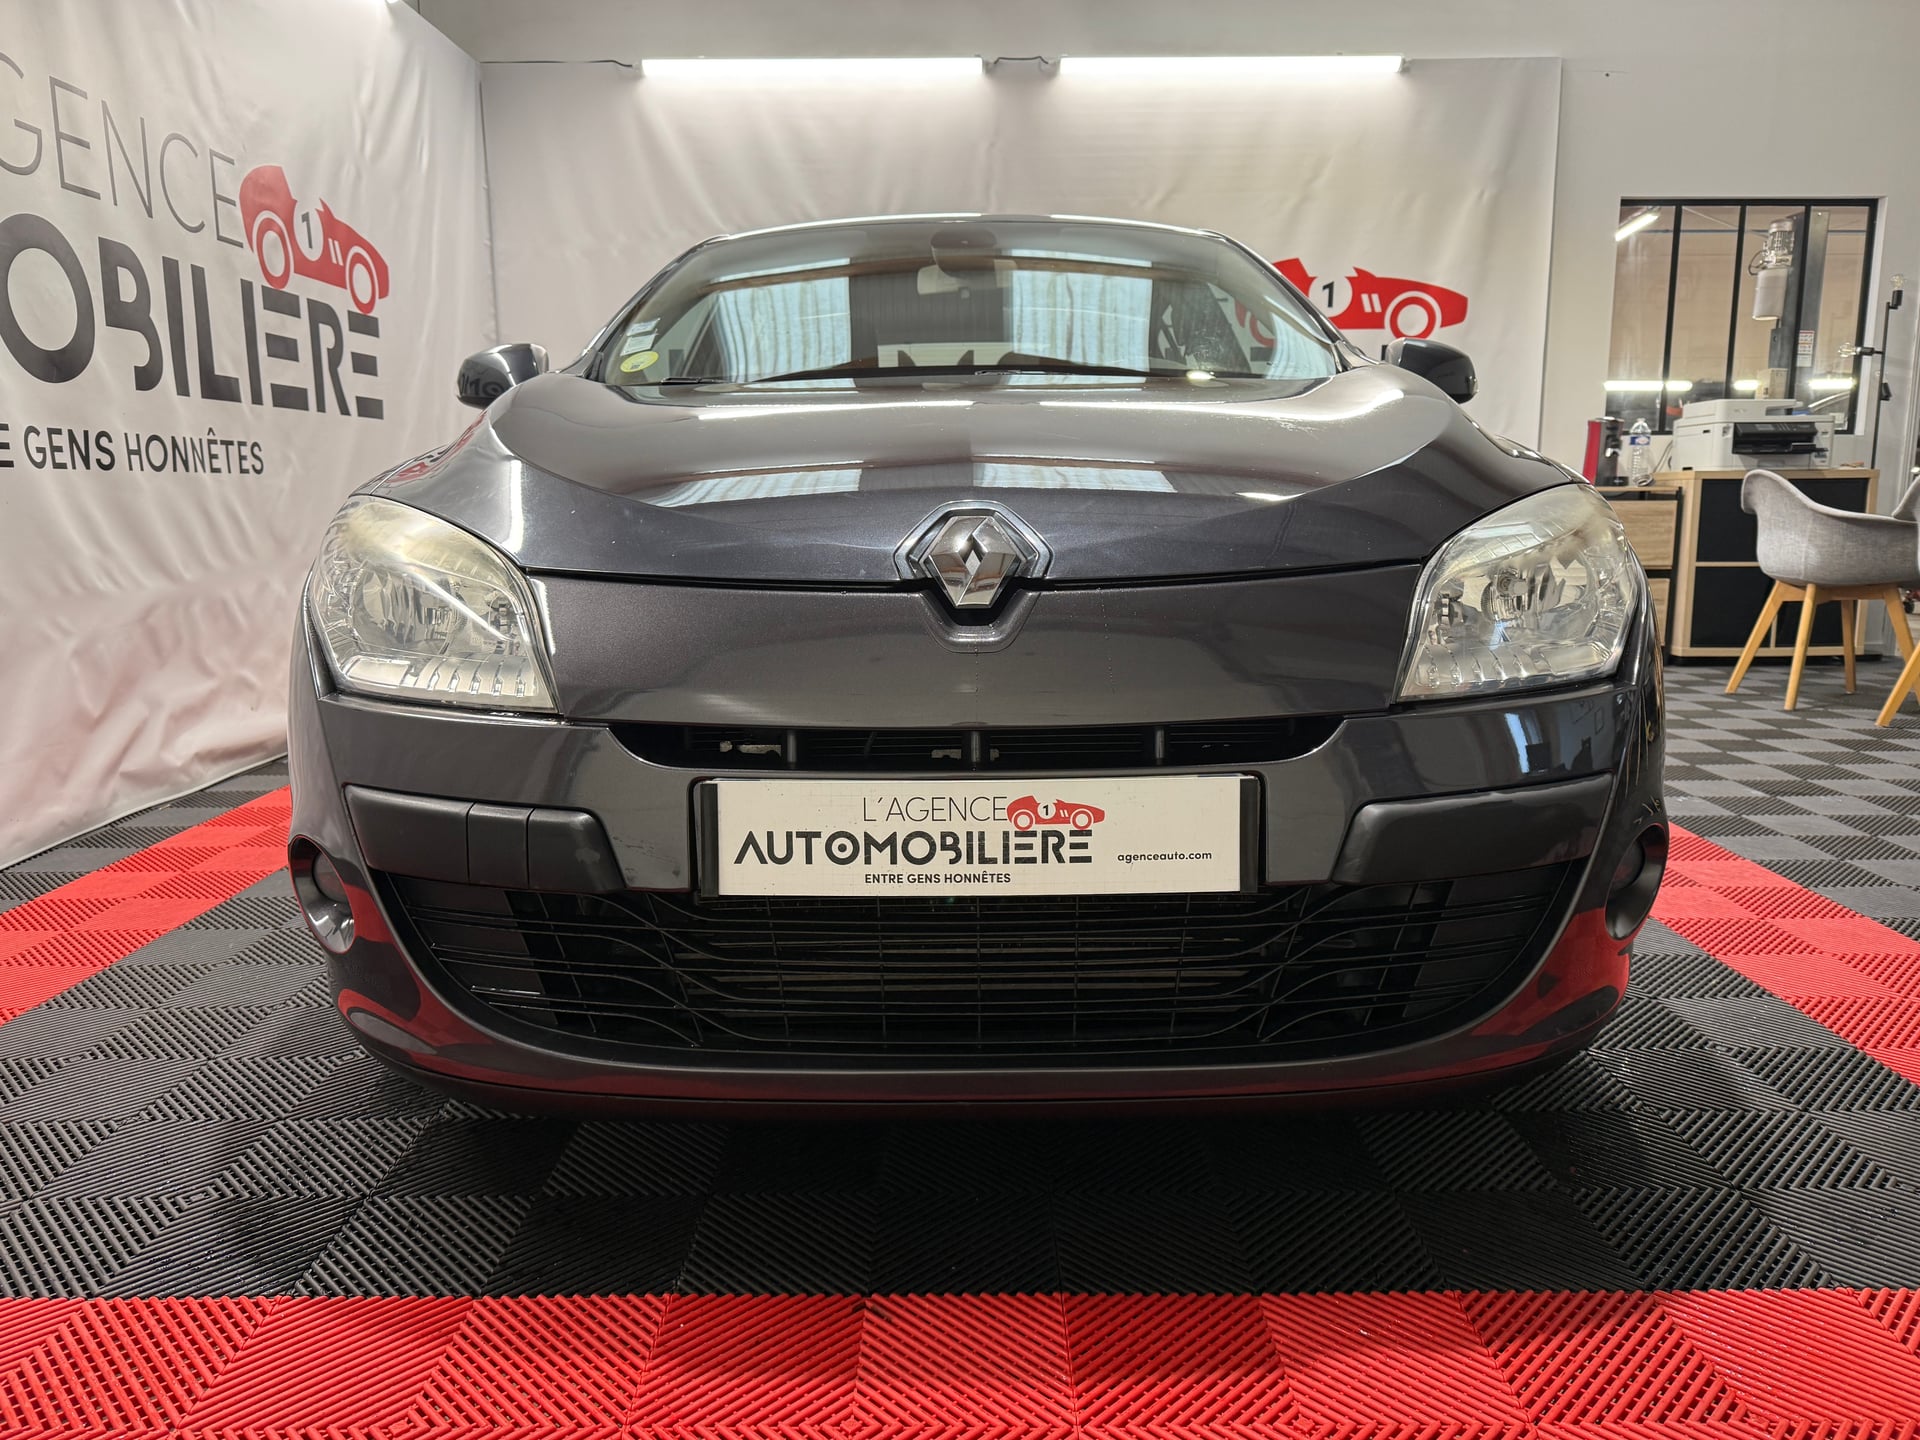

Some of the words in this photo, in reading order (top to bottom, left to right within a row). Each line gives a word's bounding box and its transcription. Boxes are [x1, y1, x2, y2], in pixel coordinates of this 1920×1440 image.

[301, 212, 313, 249] 1
[1322, 281, 1334, 308] 1
[24, 425, 116, 472] GENS
[124, 427, 264, 475] HONNÊTES
[863, 796, 1008, 822] L'AGENCE
[1042, 804, 1049, 816] 1
[735, 830, 1092, 865] AUTOMOBILIERE
[1117, 851, 1213, 864] agenceauto.com
[864, 873, 904, 884] ENTRE
[907, 873, 941, 884] GENS
[944, 870, 1011, 884] HONNÊTES
